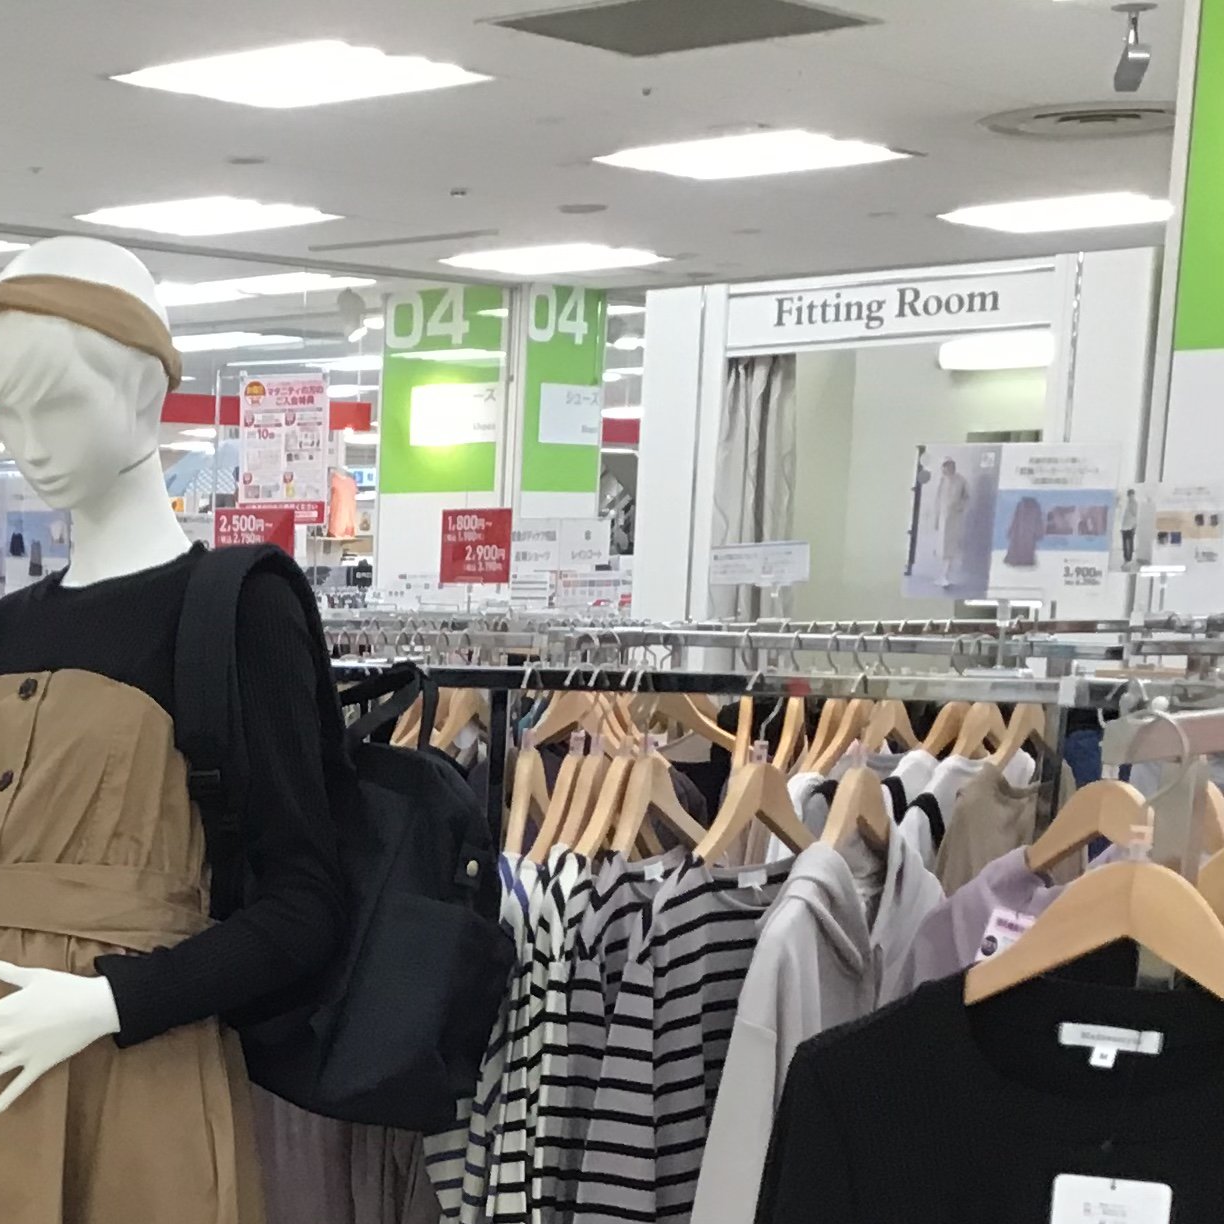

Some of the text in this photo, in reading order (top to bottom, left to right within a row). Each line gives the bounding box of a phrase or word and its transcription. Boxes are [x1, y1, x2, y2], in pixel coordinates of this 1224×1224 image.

[386, 286, 470, 349] 04
[527, 284, 588, 345] 04
[774, 286, 1001, 330] Fitting Room
